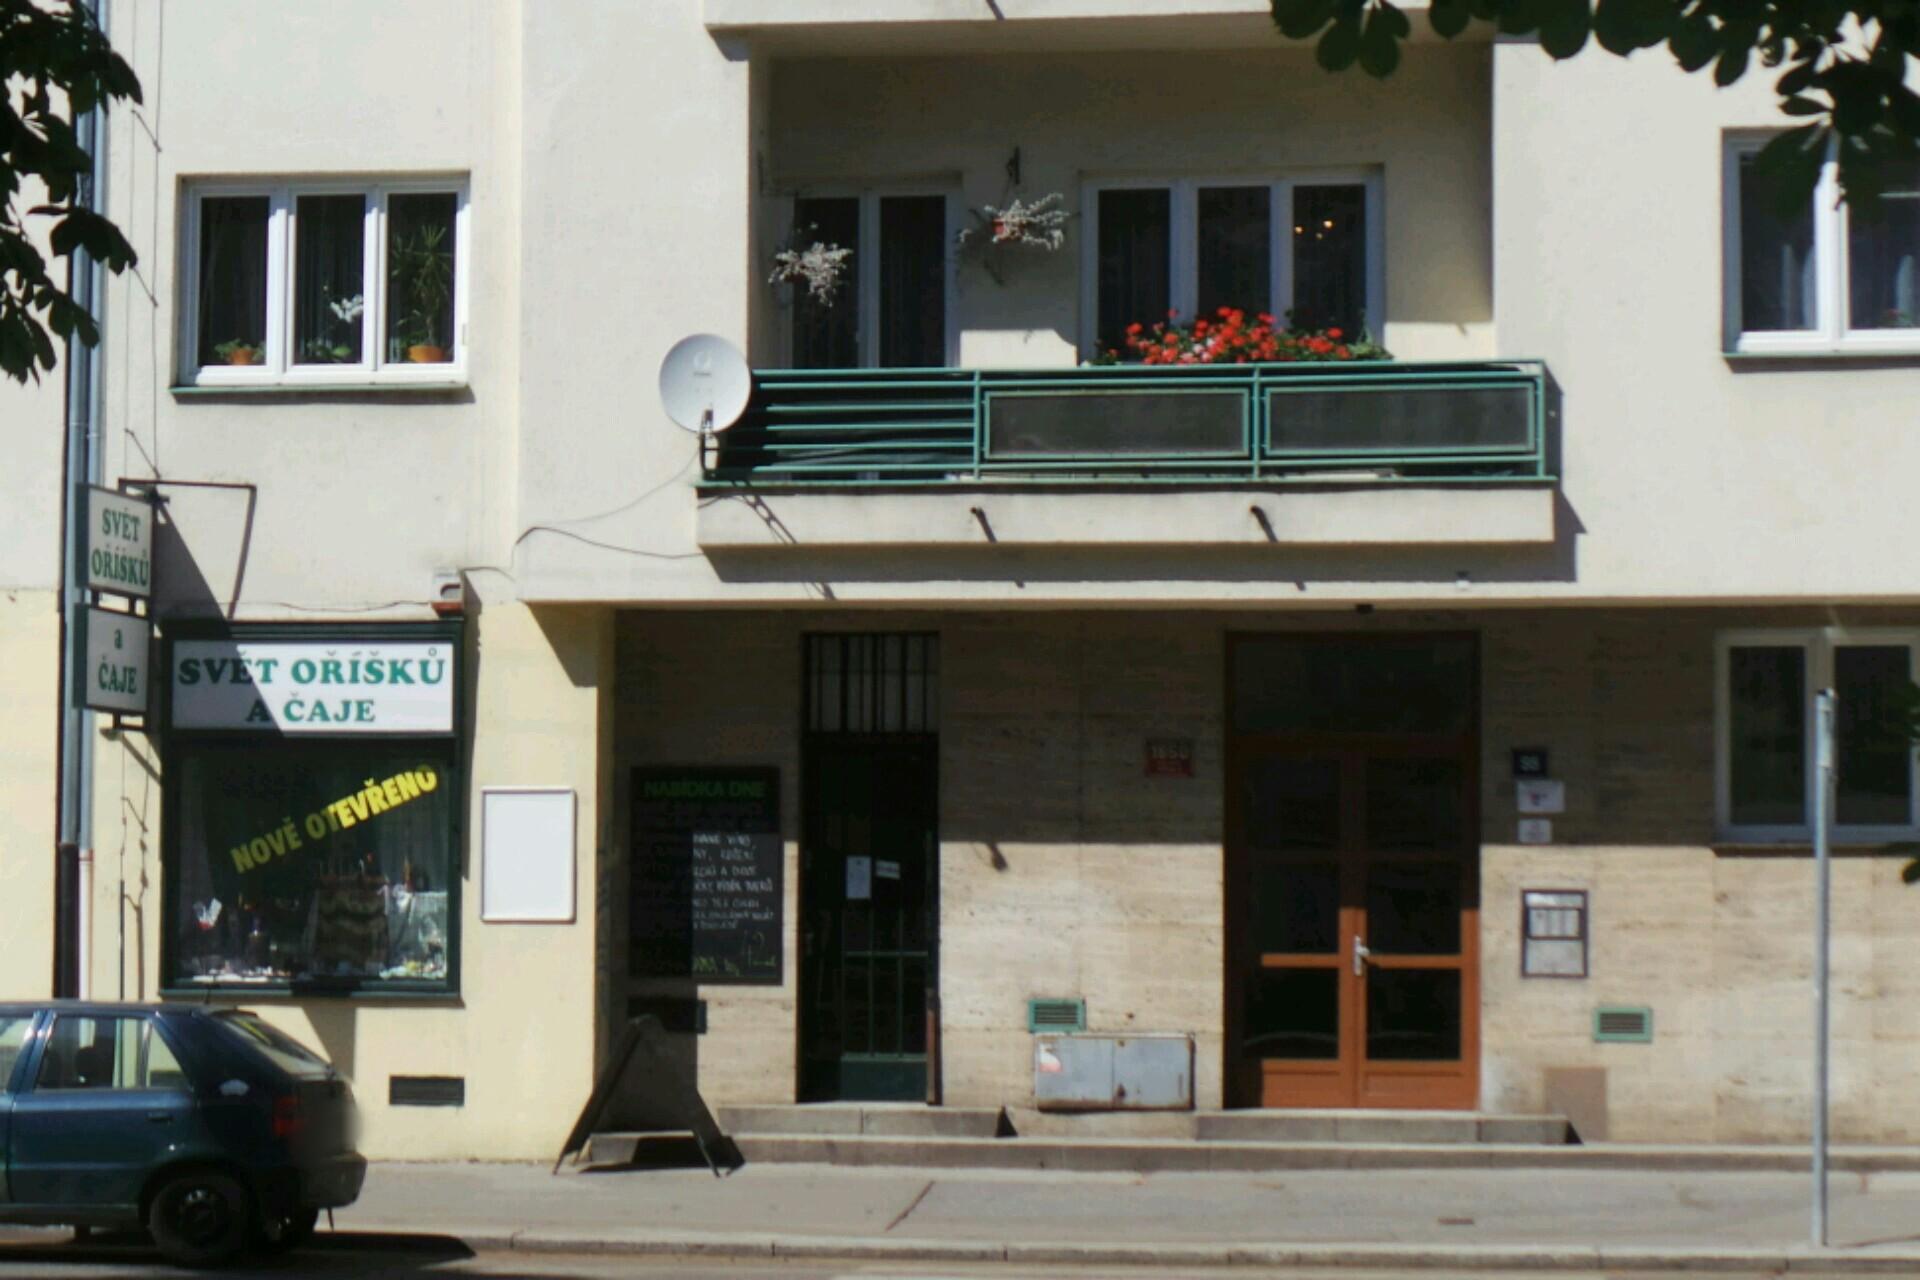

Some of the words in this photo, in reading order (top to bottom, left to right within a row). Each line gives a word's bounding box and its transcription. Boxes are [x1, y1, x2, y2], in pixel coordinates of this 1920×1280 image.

[102, 508, 140, 542] SVĚT
[92, 544, 148, 586] OŘÍŠKŮ
[114, 629, 122, 649] a
[99, 656, 137, 694] ČAJE
[178, 650, 278, 684] SVĚT
[291, 648, 445, 684] OŘÍŠKŮ
[246, 701, 270, 722] A
[283, 691, 376, 722] ČAJE
[730, 781, 766, 798] DNE
[230, 816, 302, 873] NOVĚ
[305, 764, 437, 839] OTEVŘENO
